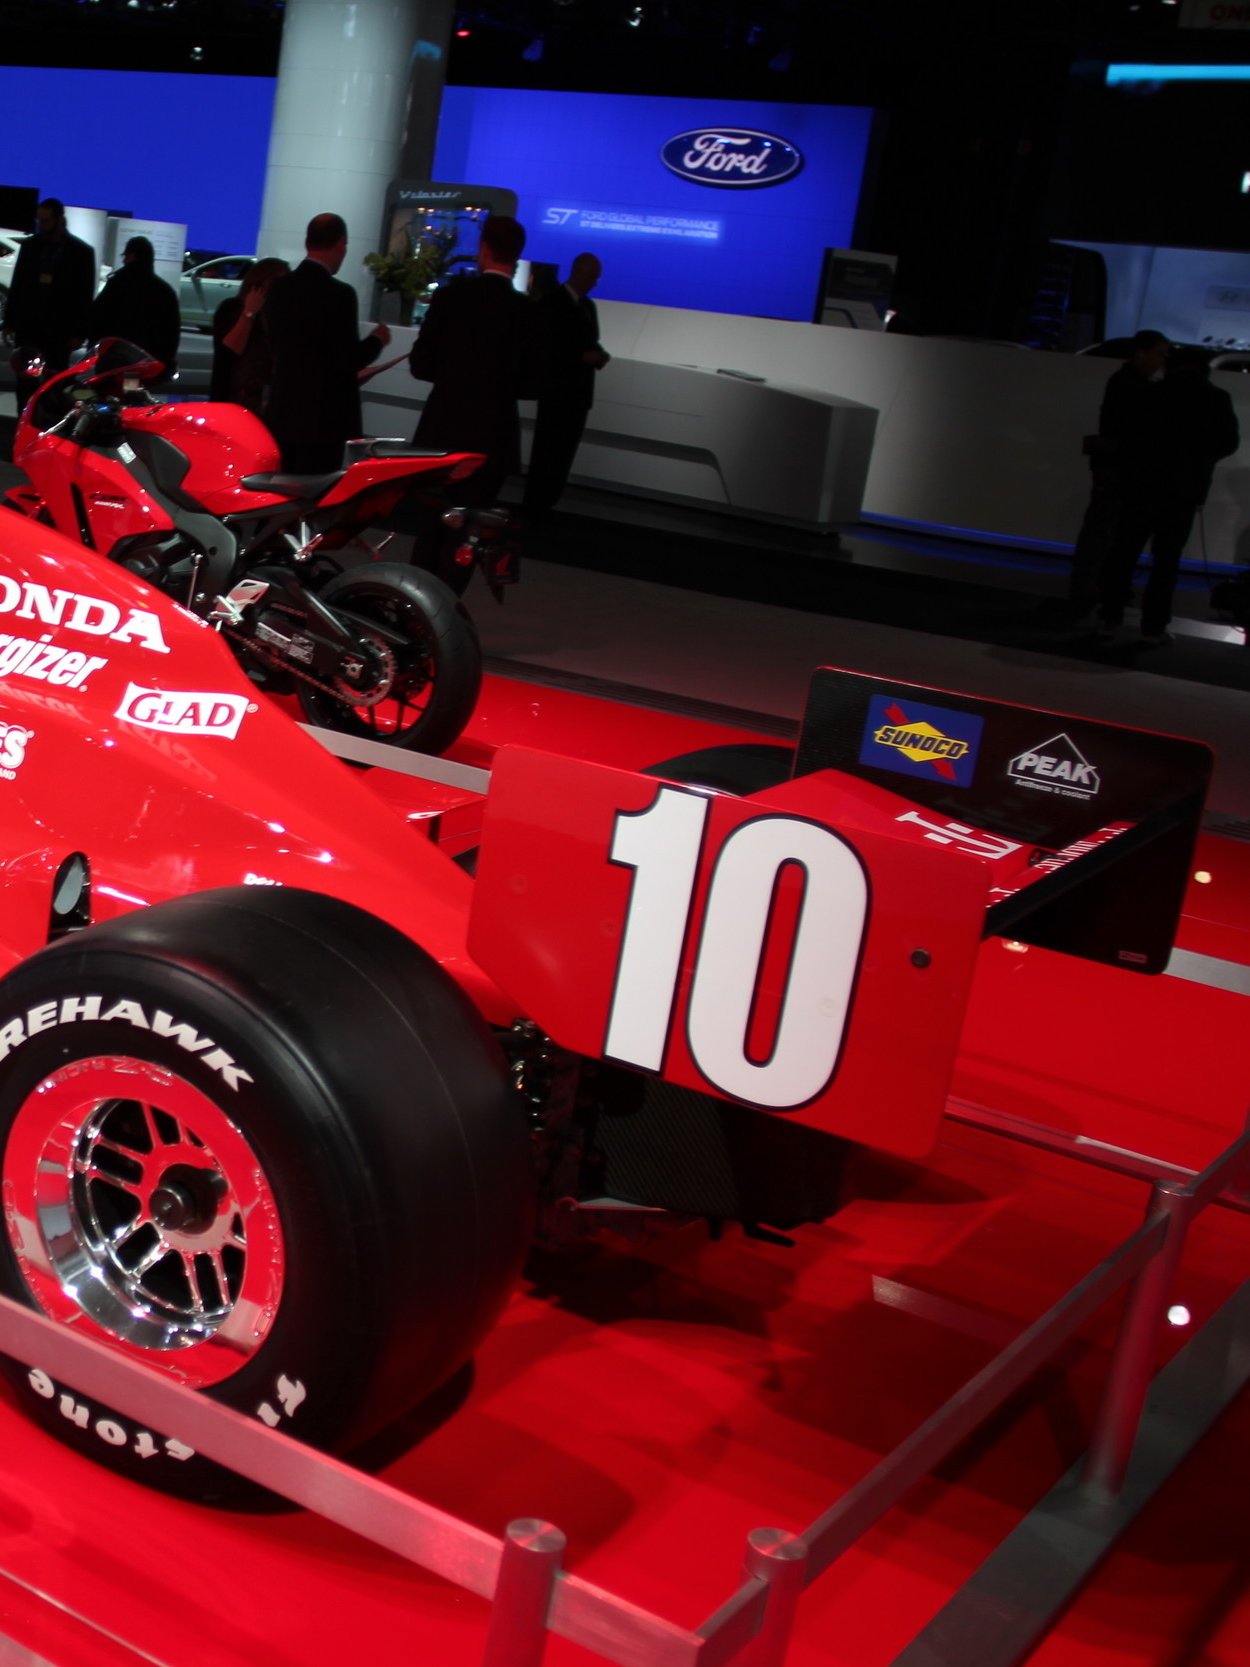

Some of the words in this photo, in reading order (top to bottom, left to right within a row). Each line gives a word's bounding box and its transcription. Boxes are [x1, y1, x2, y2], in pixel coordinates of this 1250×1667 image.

[683, 134, 771, 173] Ford
[542, 207, 579, 225] ST
[608, 212, 644, 225] GLOBAL
[646, 215, 719, 231] PERFORMANCE
[127, 692, 236, 727] GLAD
[878, 727, 964, 757] SUNOCO
[1017, 753, 1097, 784] PEAK
[602, 782, 872, 1112] 10
